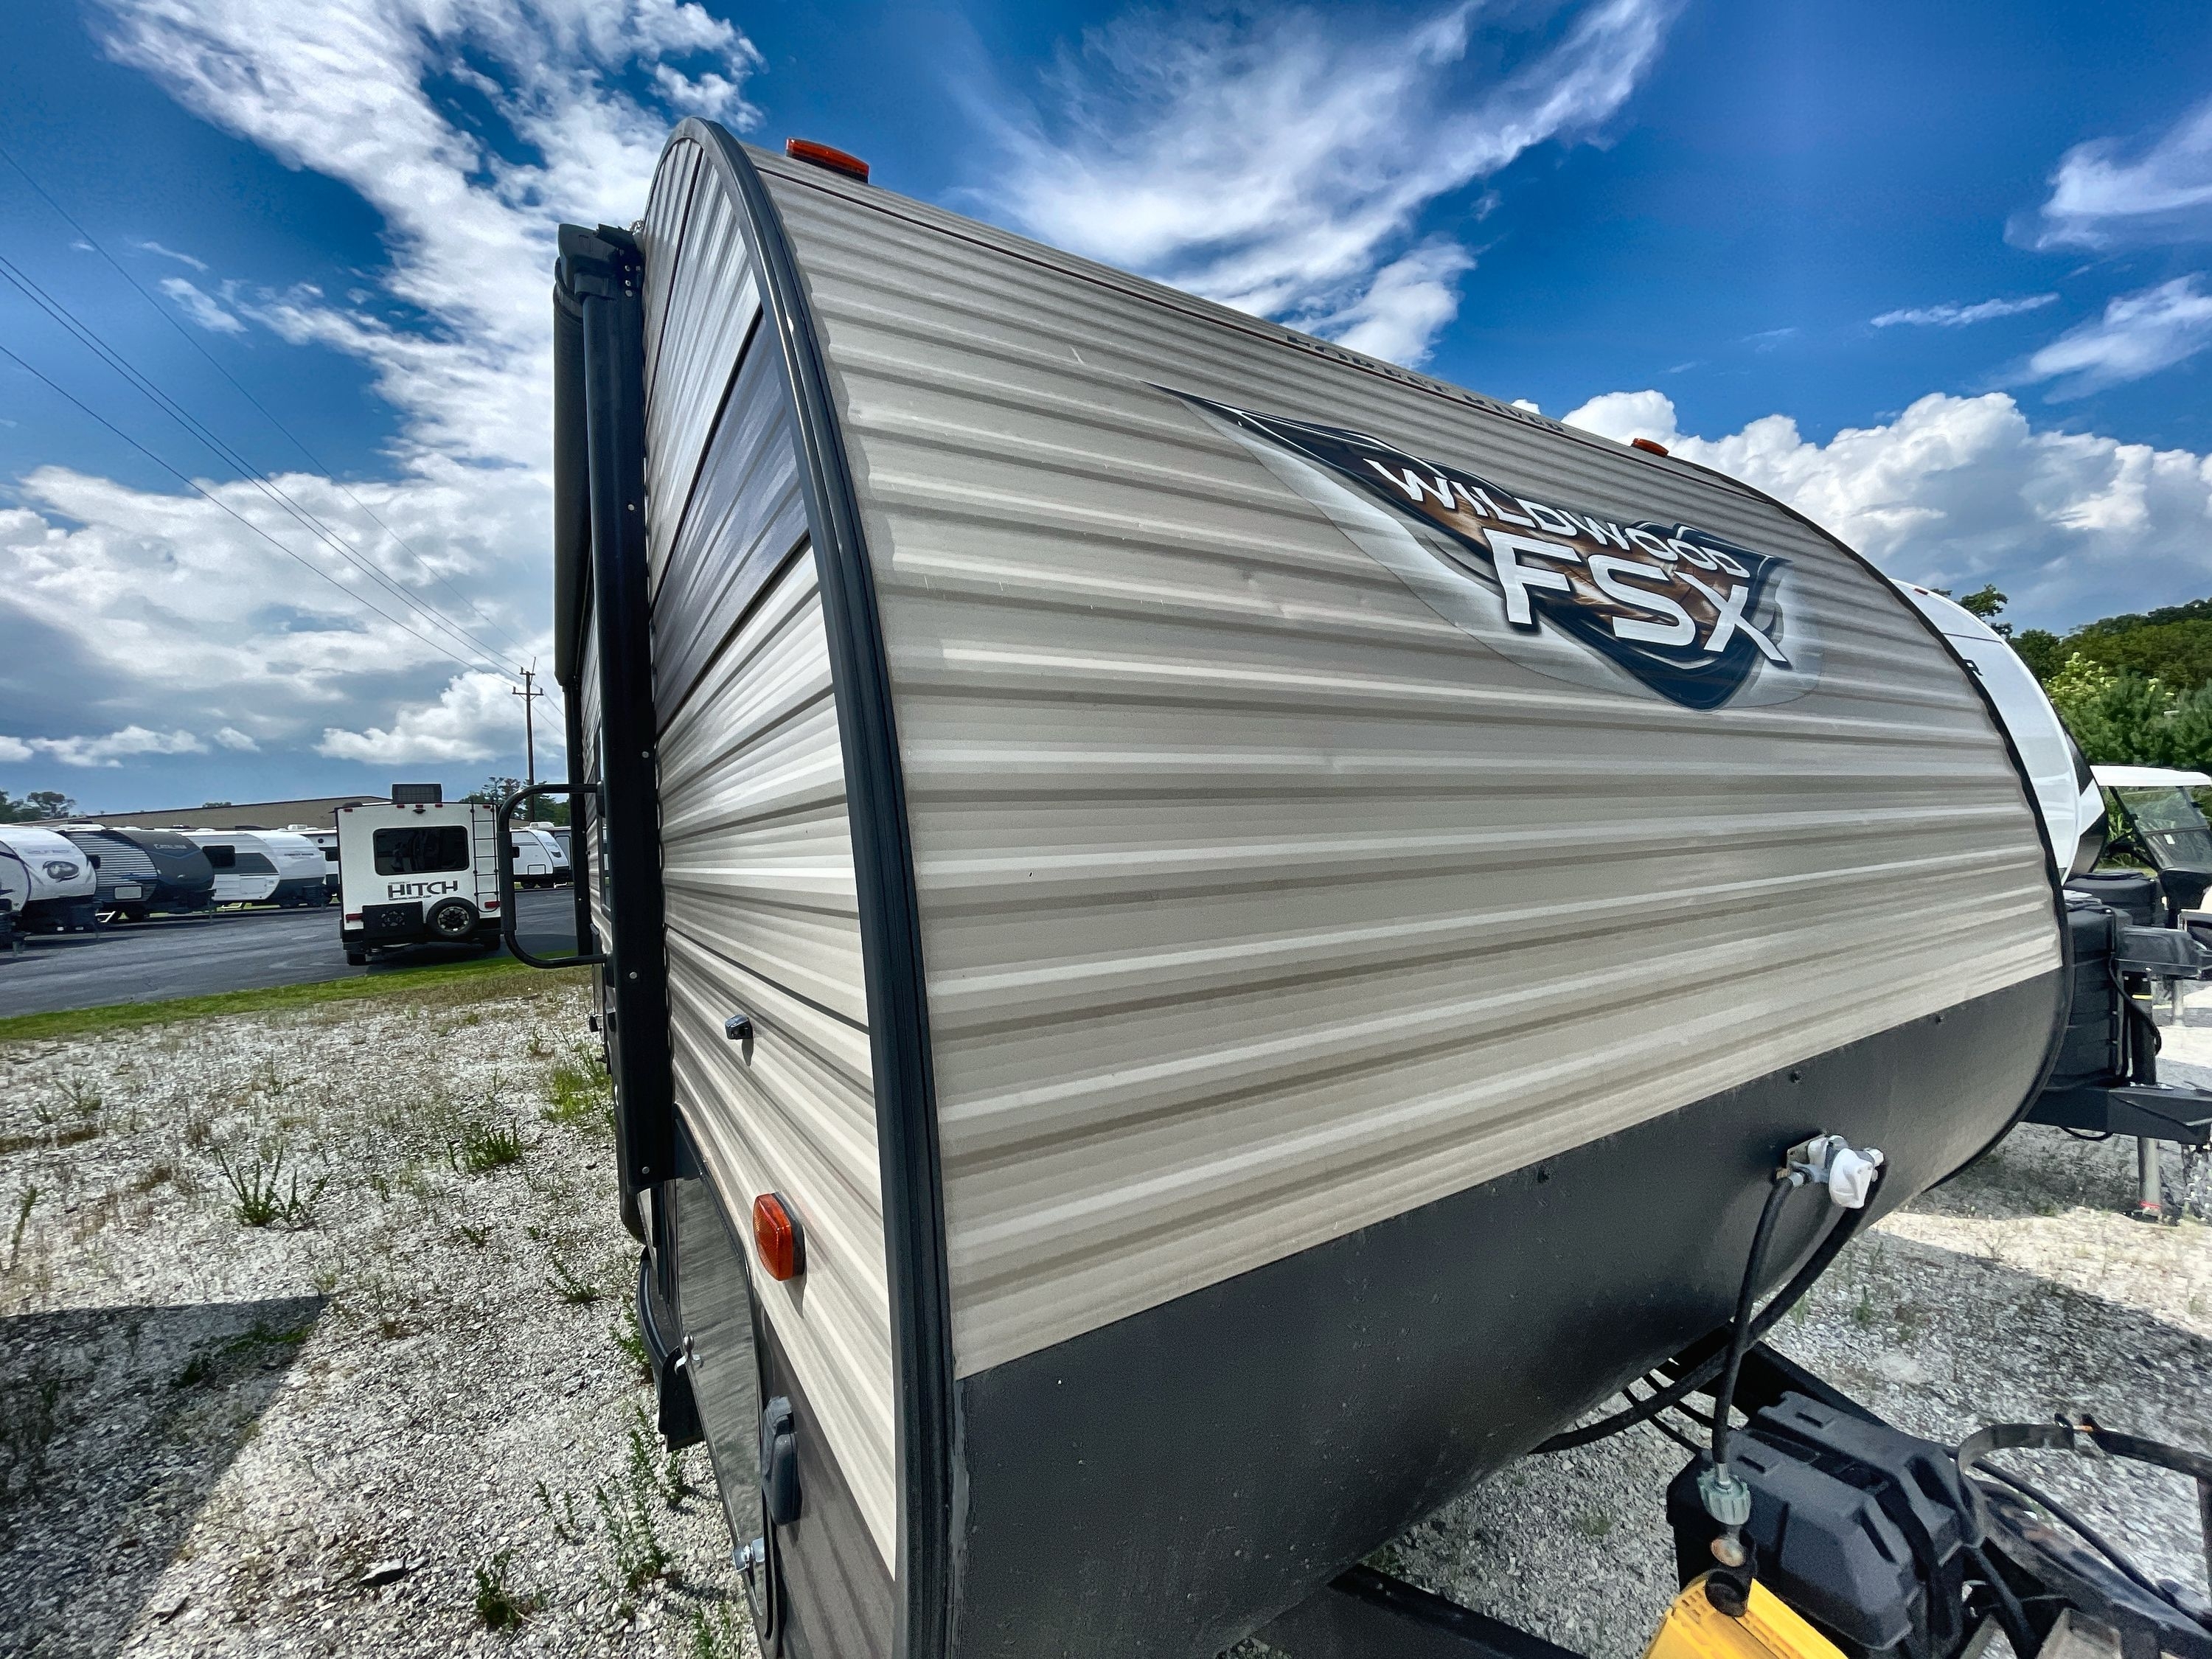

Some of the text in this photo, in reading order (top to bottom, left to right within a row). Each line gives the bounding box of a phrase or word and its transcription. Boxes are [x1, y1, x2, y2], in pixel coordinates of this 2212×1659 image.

[1363, 457, 1750, 579] WILDWOOD
[1481, 526, 1792, 664] FSX
[387, 880, 458, 898] HITCH
